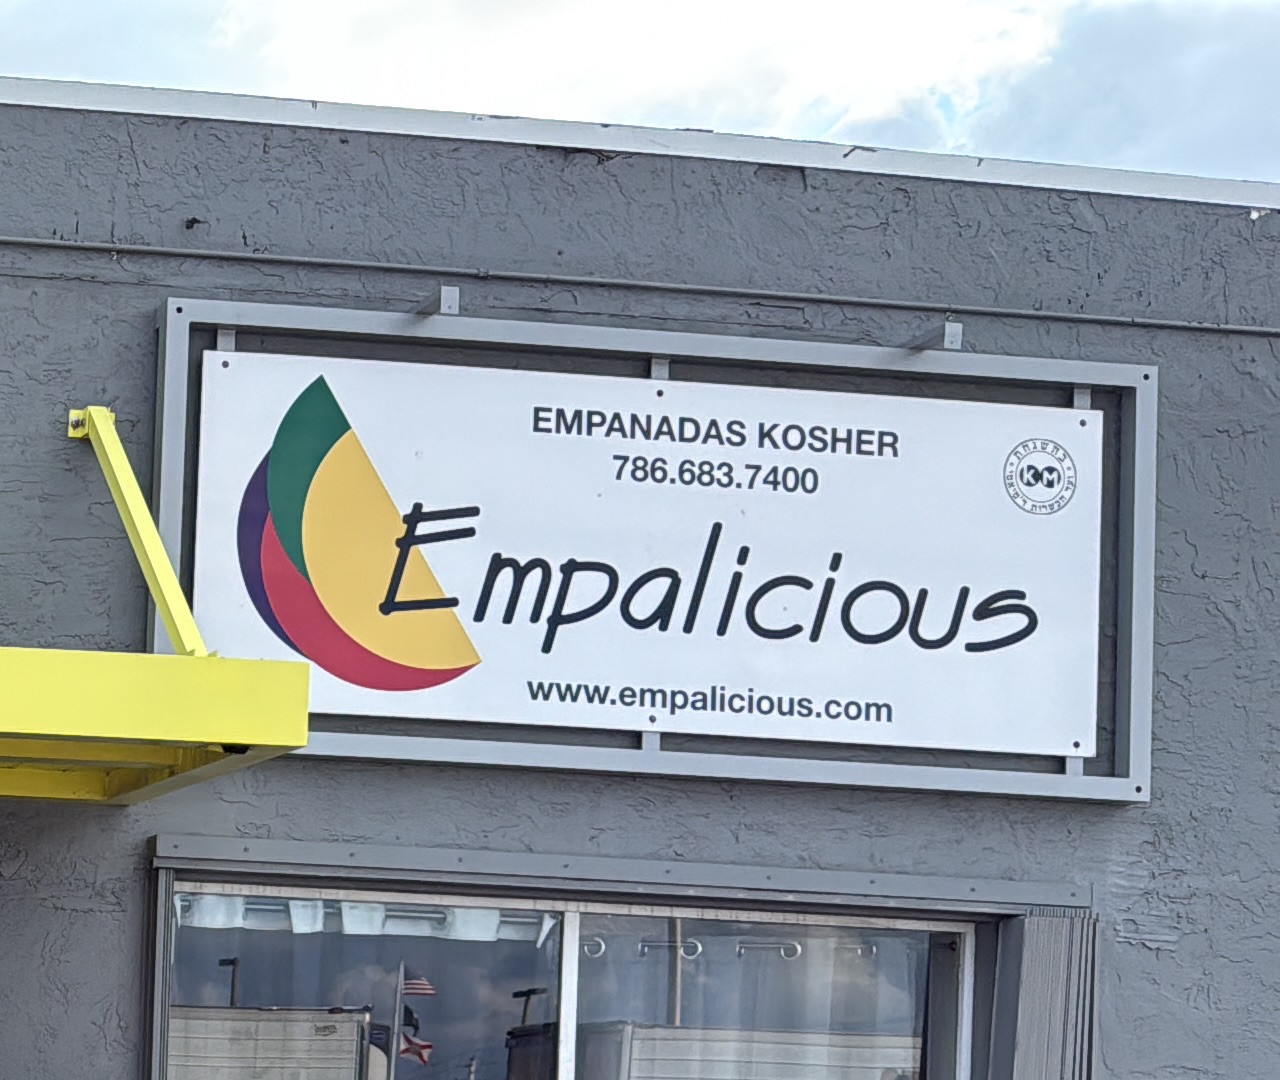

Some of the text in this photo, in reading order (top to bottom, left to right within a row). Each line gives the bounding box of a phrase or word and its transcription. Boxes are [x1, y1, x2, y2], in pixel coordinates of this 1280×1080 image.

[532, 406, 899, 459] EMPANADAS KOSHER
[612, 454, 819, 495] 786.683.7400
[378, 502, 1038, 655] Empalicious
[526, 680, 894, 725] www.empalicious.com
